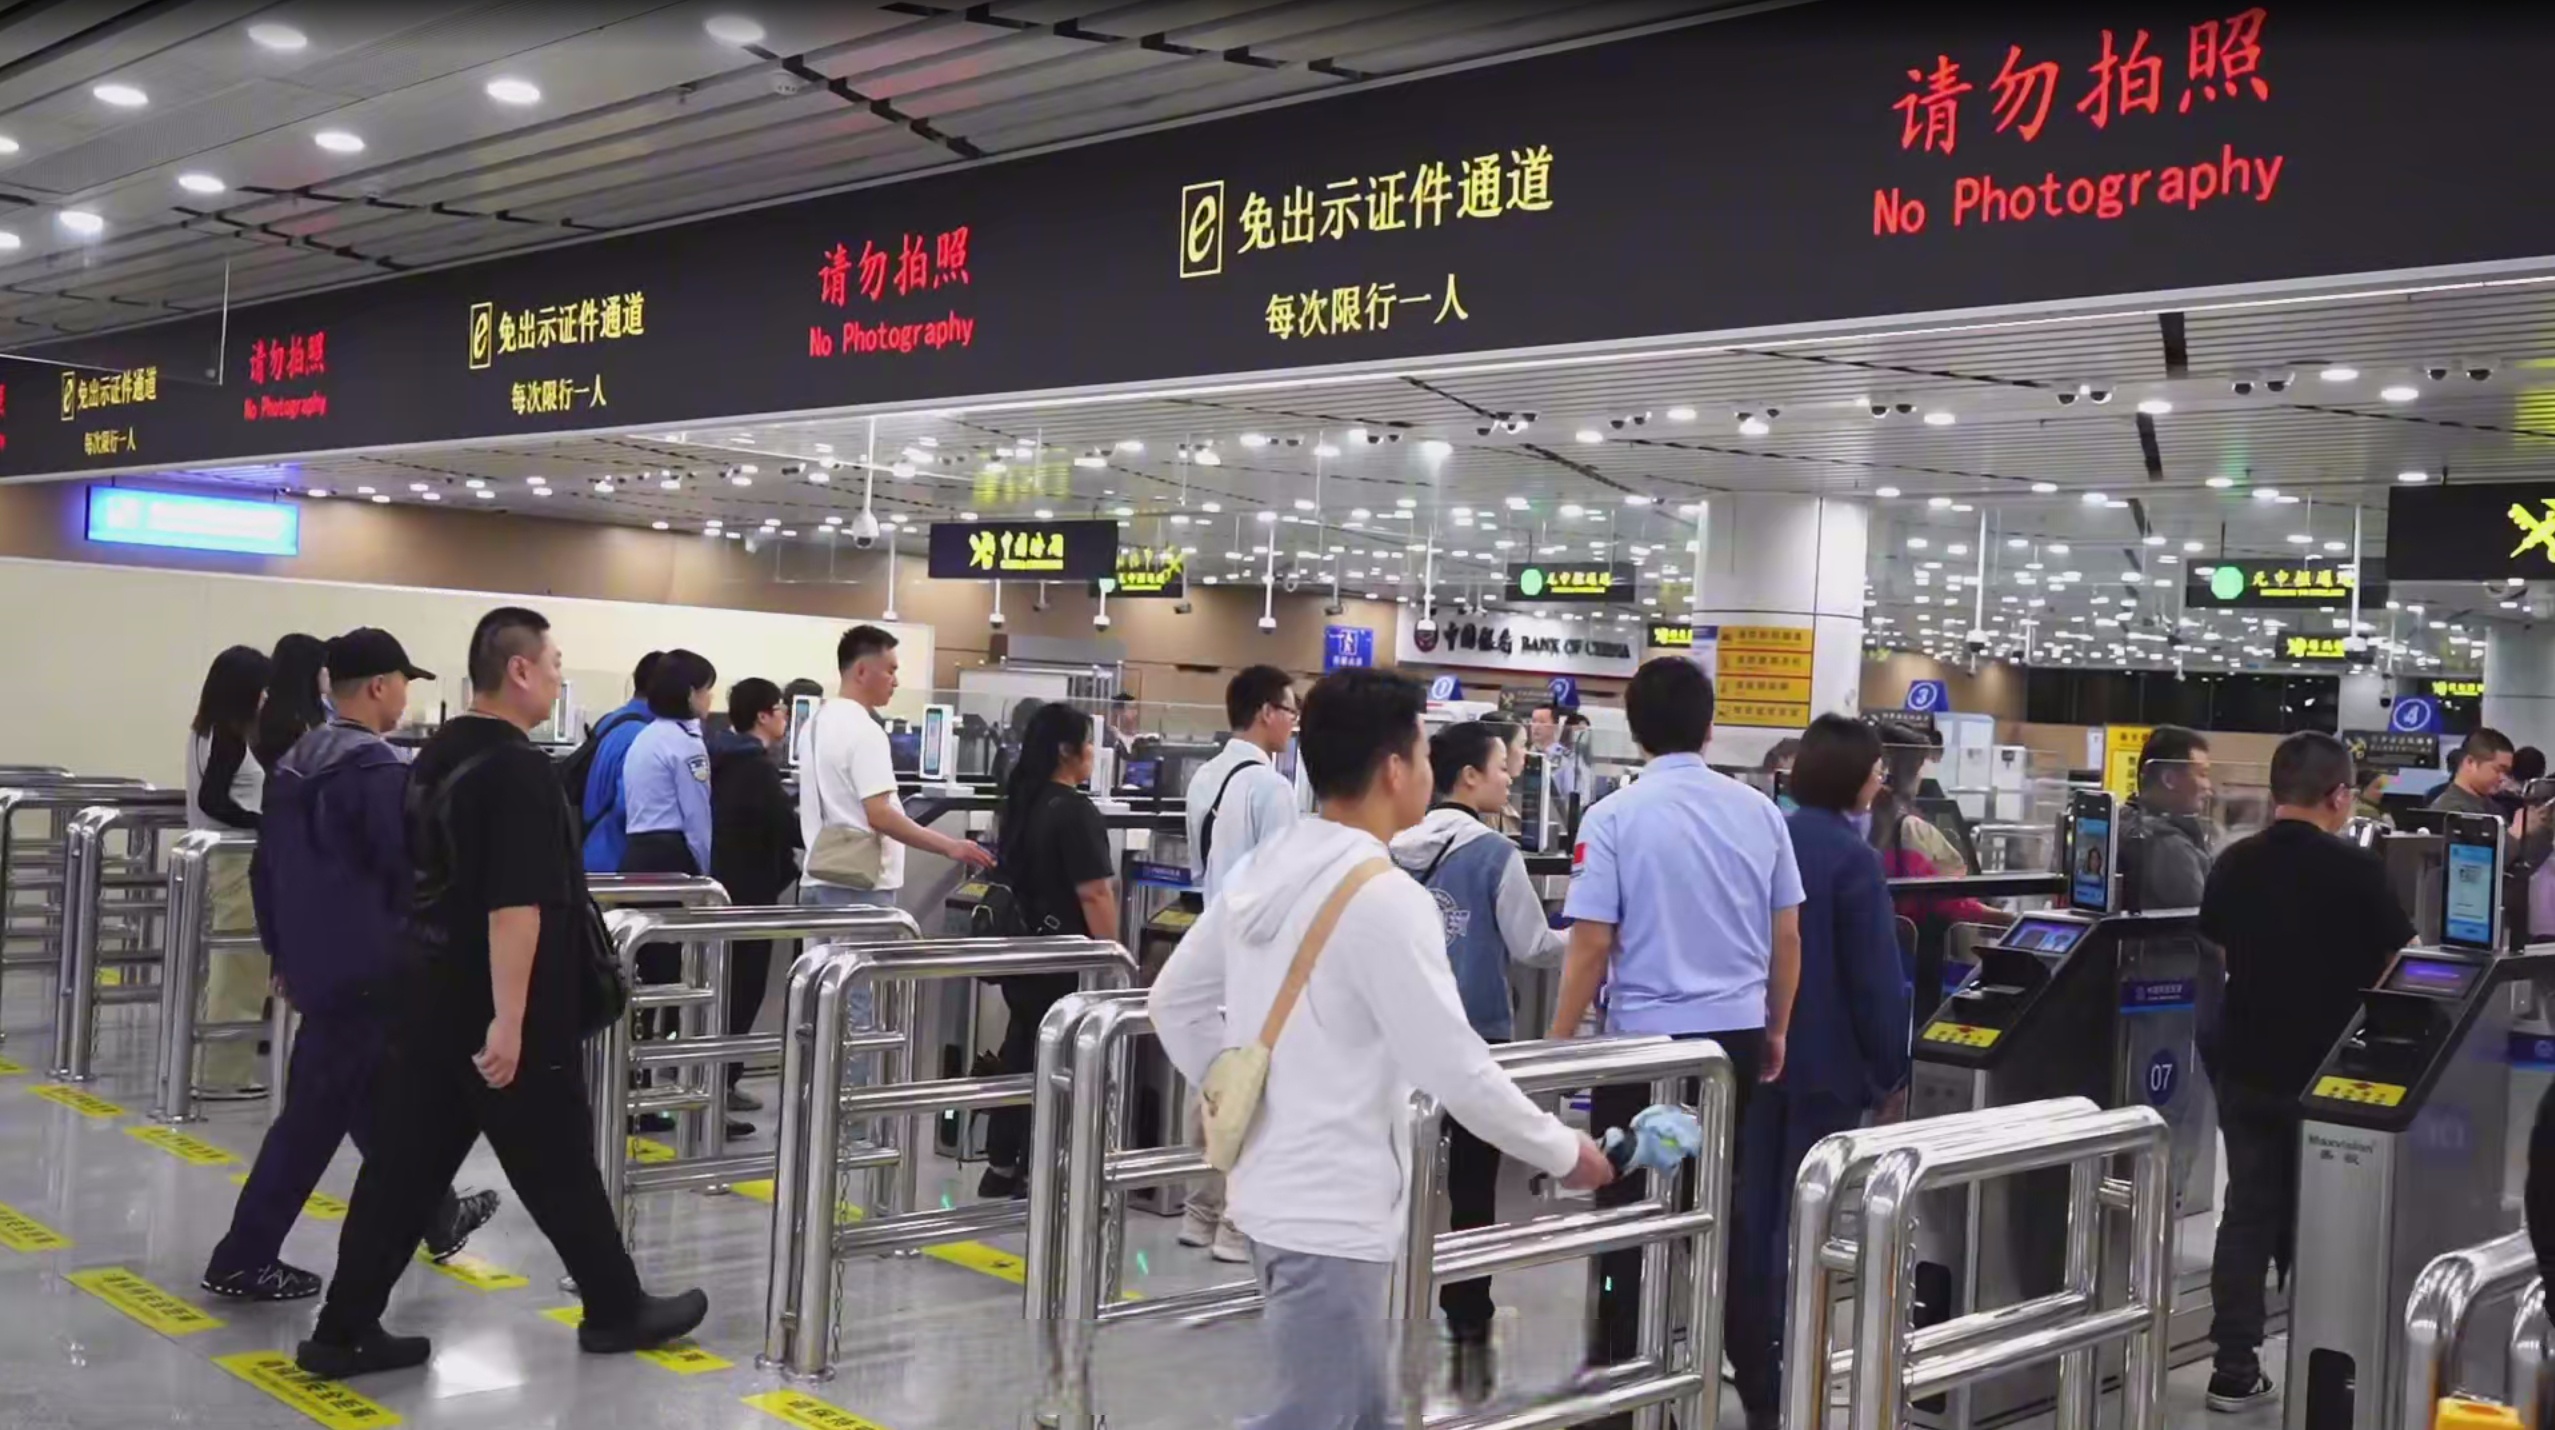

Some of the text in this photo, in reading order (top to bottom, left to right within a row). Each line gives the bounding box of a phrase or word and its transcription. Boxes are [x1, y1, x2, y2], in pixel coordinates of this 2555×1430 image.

[1892, 8, 2270, 155] 请勿拍照
[1238, 146, 1555, 252] 免出示证件通道
[1873, 144, 2284, 236] No Photography
[818, 226, 971, 308] 请勿拍照
[497, 292, 645, 354] 免出示证件通道
[1266, 274, 1469, 341] 每次限行一人
[249, 331, 327, 384] 请勿拍照
[809, 313, 974, 358] No Photography
[77, 366, 157, 410] 免出示证件通道
[244, 391, 328, 421] No Photography
[511, 376, 607, 416] 每次限行一人
[84, 427, 136, 457] 每次限行一人
[2149, 1063, 2173, 1092] 07
